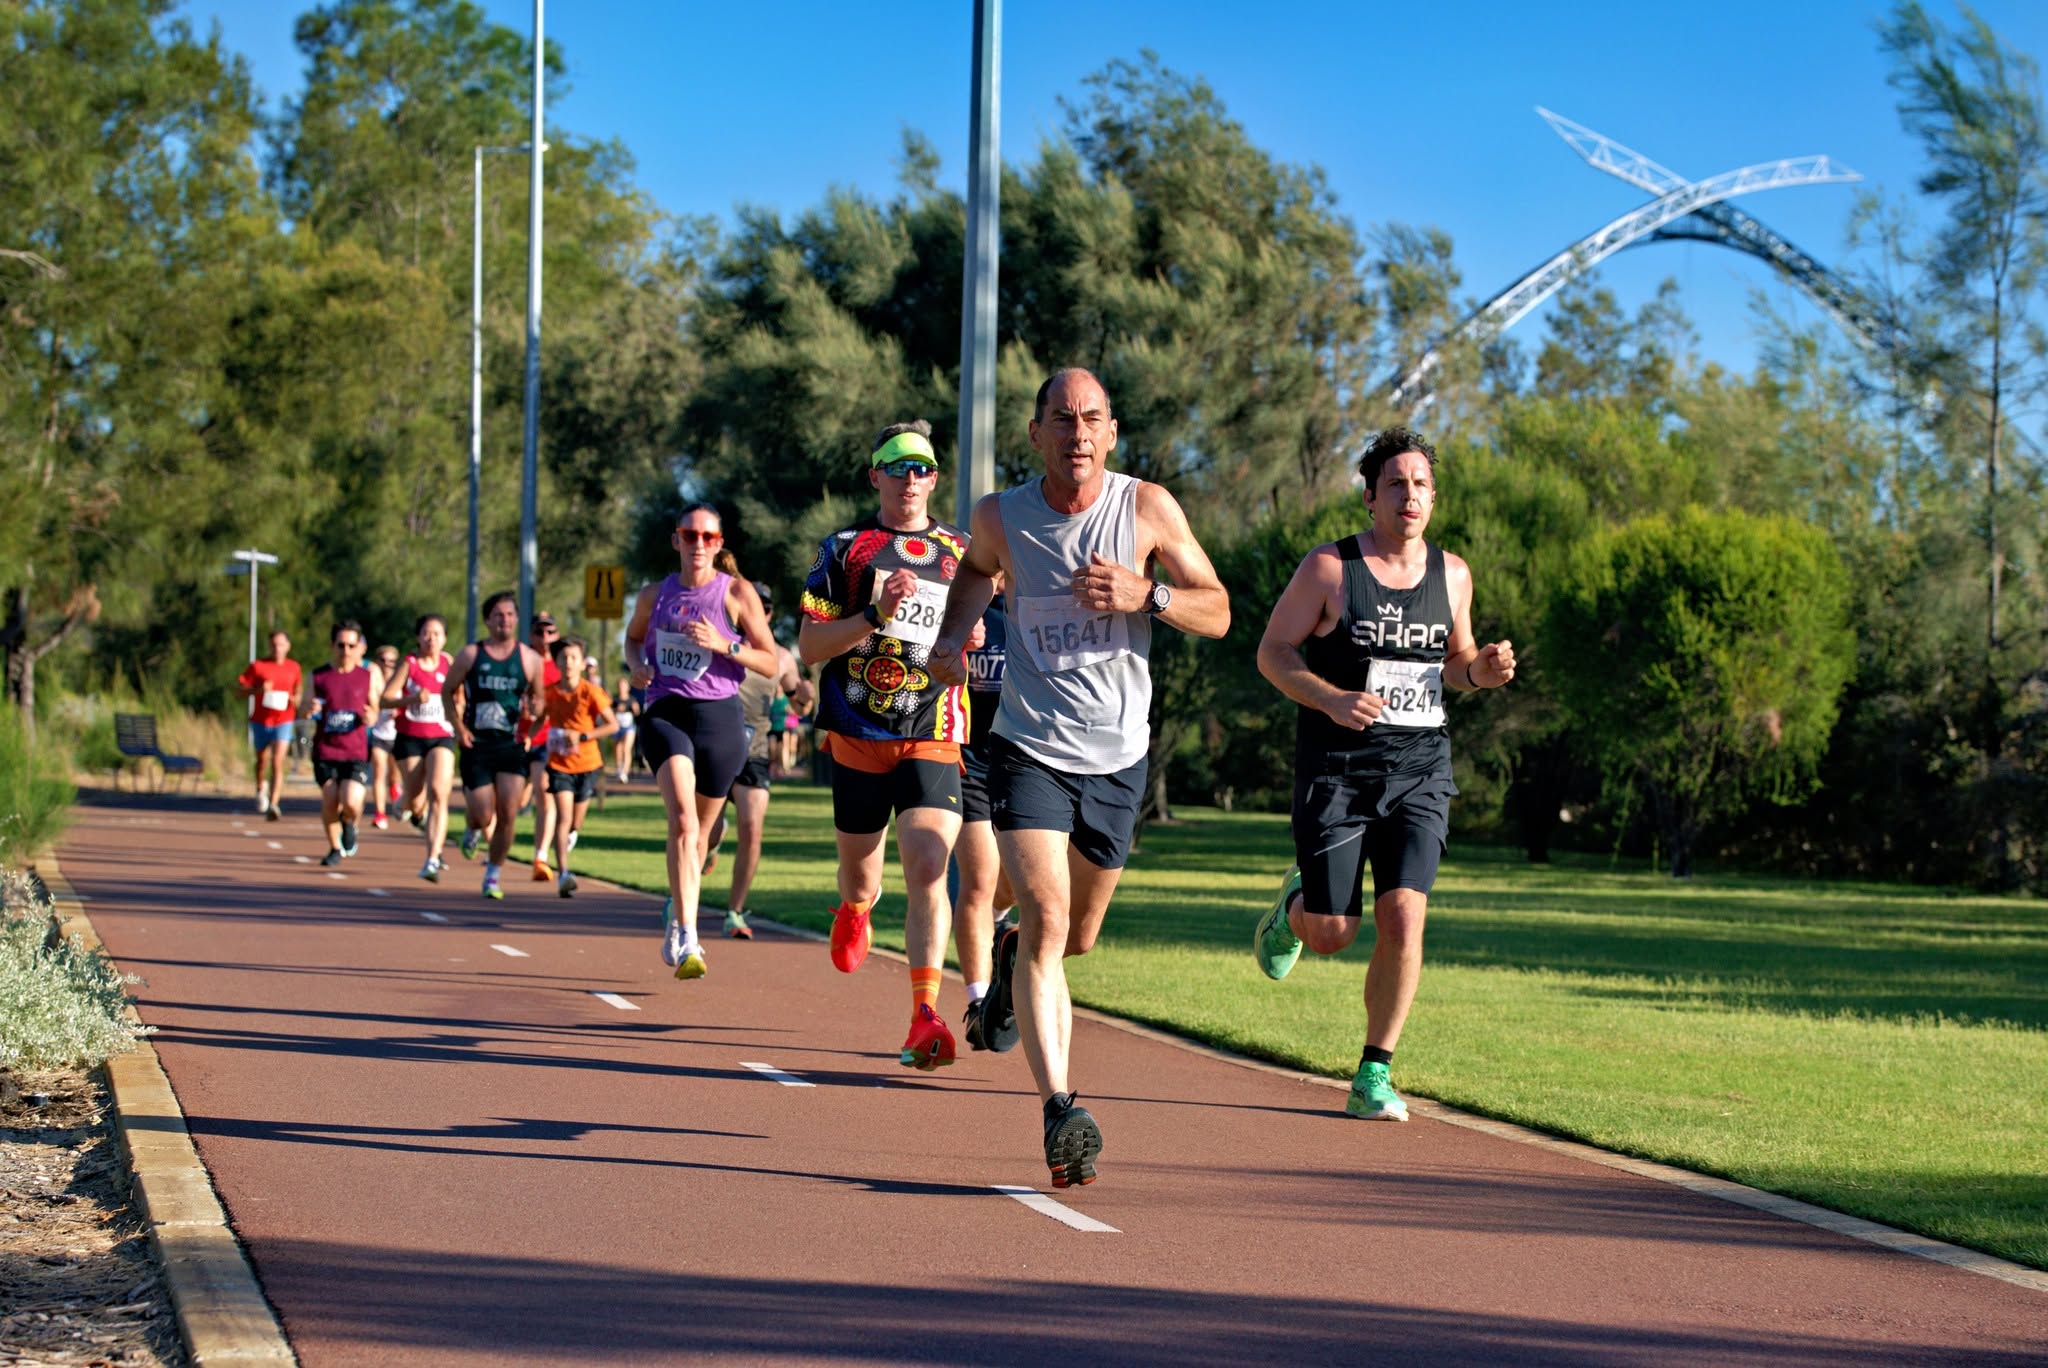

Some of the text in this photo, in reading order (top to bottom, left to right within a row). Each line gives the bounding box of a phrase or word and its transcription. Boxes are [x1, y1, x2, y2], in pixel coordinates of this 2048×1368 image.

[1029, 614, 1113, 654] 15647
[661, 648, 701, 672] 10822
[1375, 685, 1437, 713] 16247
